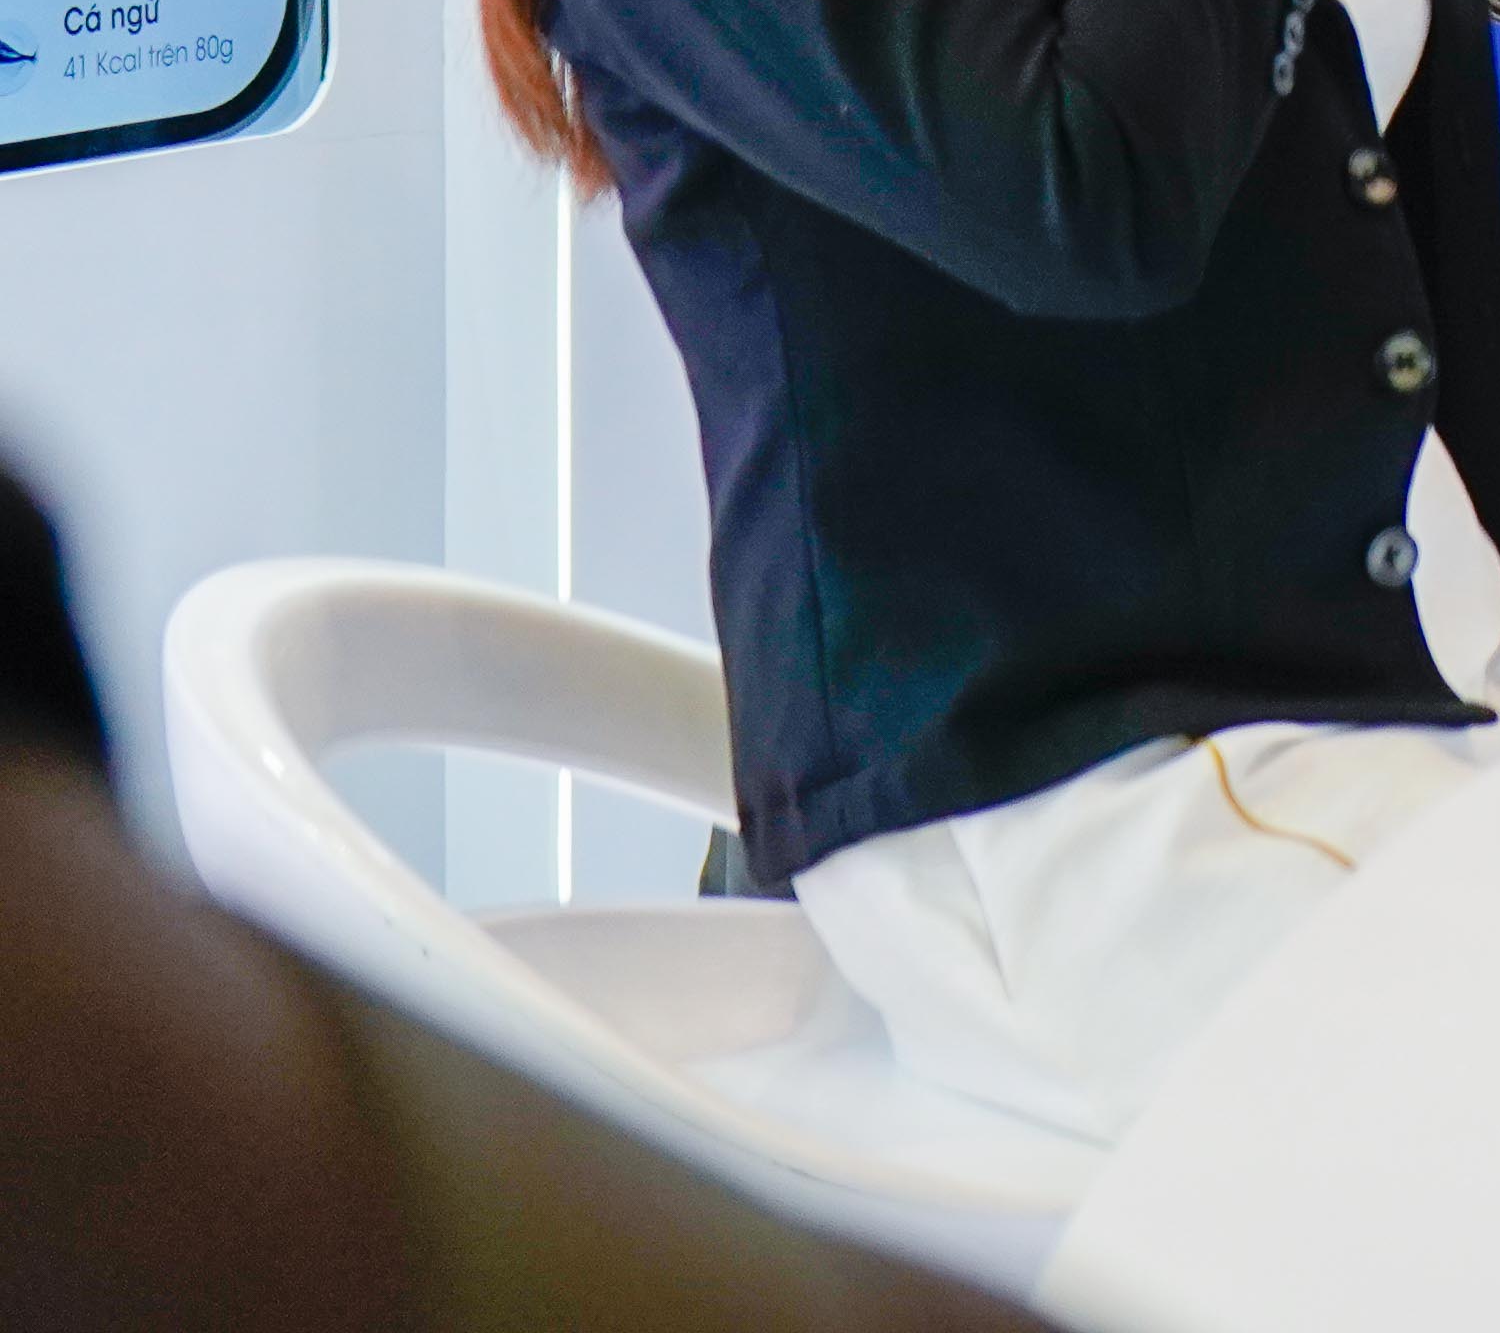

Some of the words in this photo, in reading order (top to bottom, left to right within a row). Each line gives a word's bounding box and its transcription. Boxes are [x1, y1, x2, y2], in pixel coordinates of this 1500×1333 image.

[64, 3, 102, 36] Cá
[63, 53, 86, 81] 41
[97, 46, 142, 77] Kcal
[149, 43, 188, 69] trên
[195, 34, 234, 65] 80g
